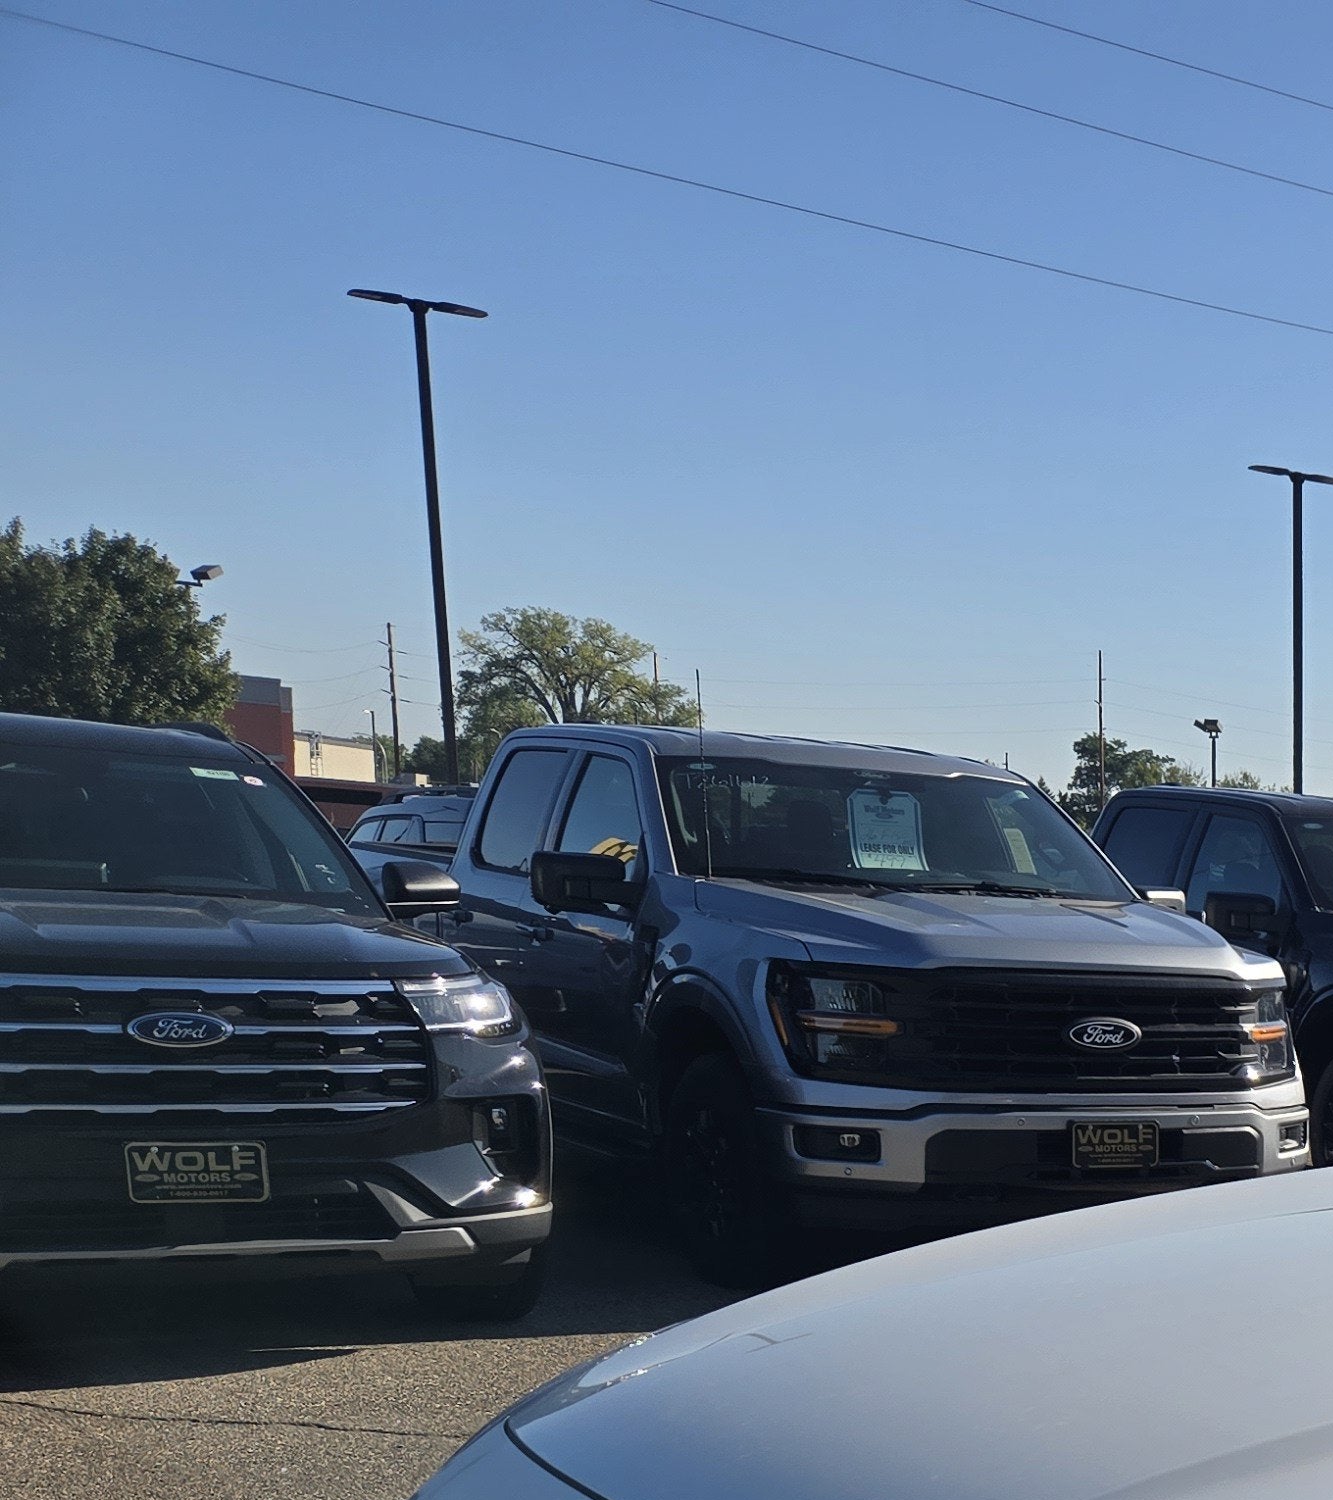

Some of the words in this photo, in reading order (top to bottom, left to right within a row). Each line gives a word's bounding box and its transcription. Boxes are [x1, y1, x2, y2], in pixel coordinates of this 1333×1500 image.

[860, 842, 881, 853] LEASE
[882, 844, 897, 854] FOR
[898, 844, 915, 855] ONLY
[153, 1018, 207, 1039] Ford
[1083, 1025, 1124, 1044] Ford
[1077, 1128, 1154, 1144] WOLF
[1095, 1144, 1137, 1152] MOTORS
[131, 1151, 256, 1171] WOLF
[163, 1173, 231, 1183] MOTORS
